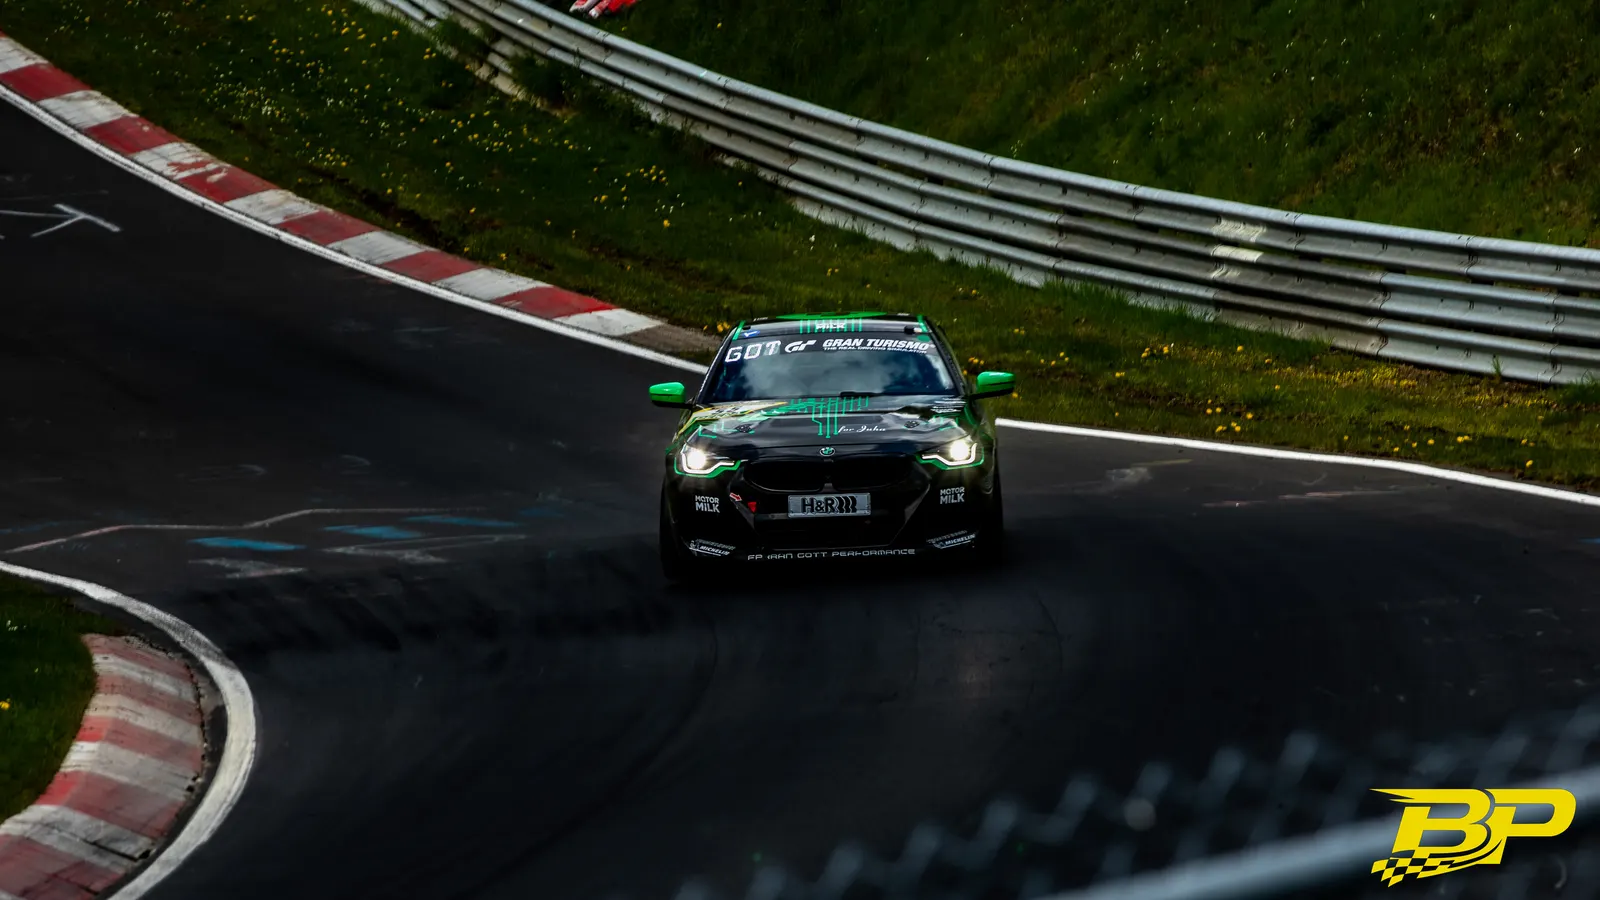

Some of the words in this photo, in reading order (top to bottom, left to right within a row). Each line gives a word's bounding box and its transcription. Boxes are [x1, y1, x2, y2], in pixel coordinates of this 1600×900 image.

[823, 339, 863, 348] GRAN
[866, 339, 930, 351] TURISMO
[940, 486, 965, 496] MOTOR
[695, 495, 720, 504] MOTOR
[940, 493, 965, 504] MILK
[695, 501, 721, 513] MILK
[945, 533, 976, 546] MICHELIN
[700, 545, 731, 556] MICHELIN
[797, 551, 828, 559] GOTT
[831, 548, 916, 558] PERFORMANCE
